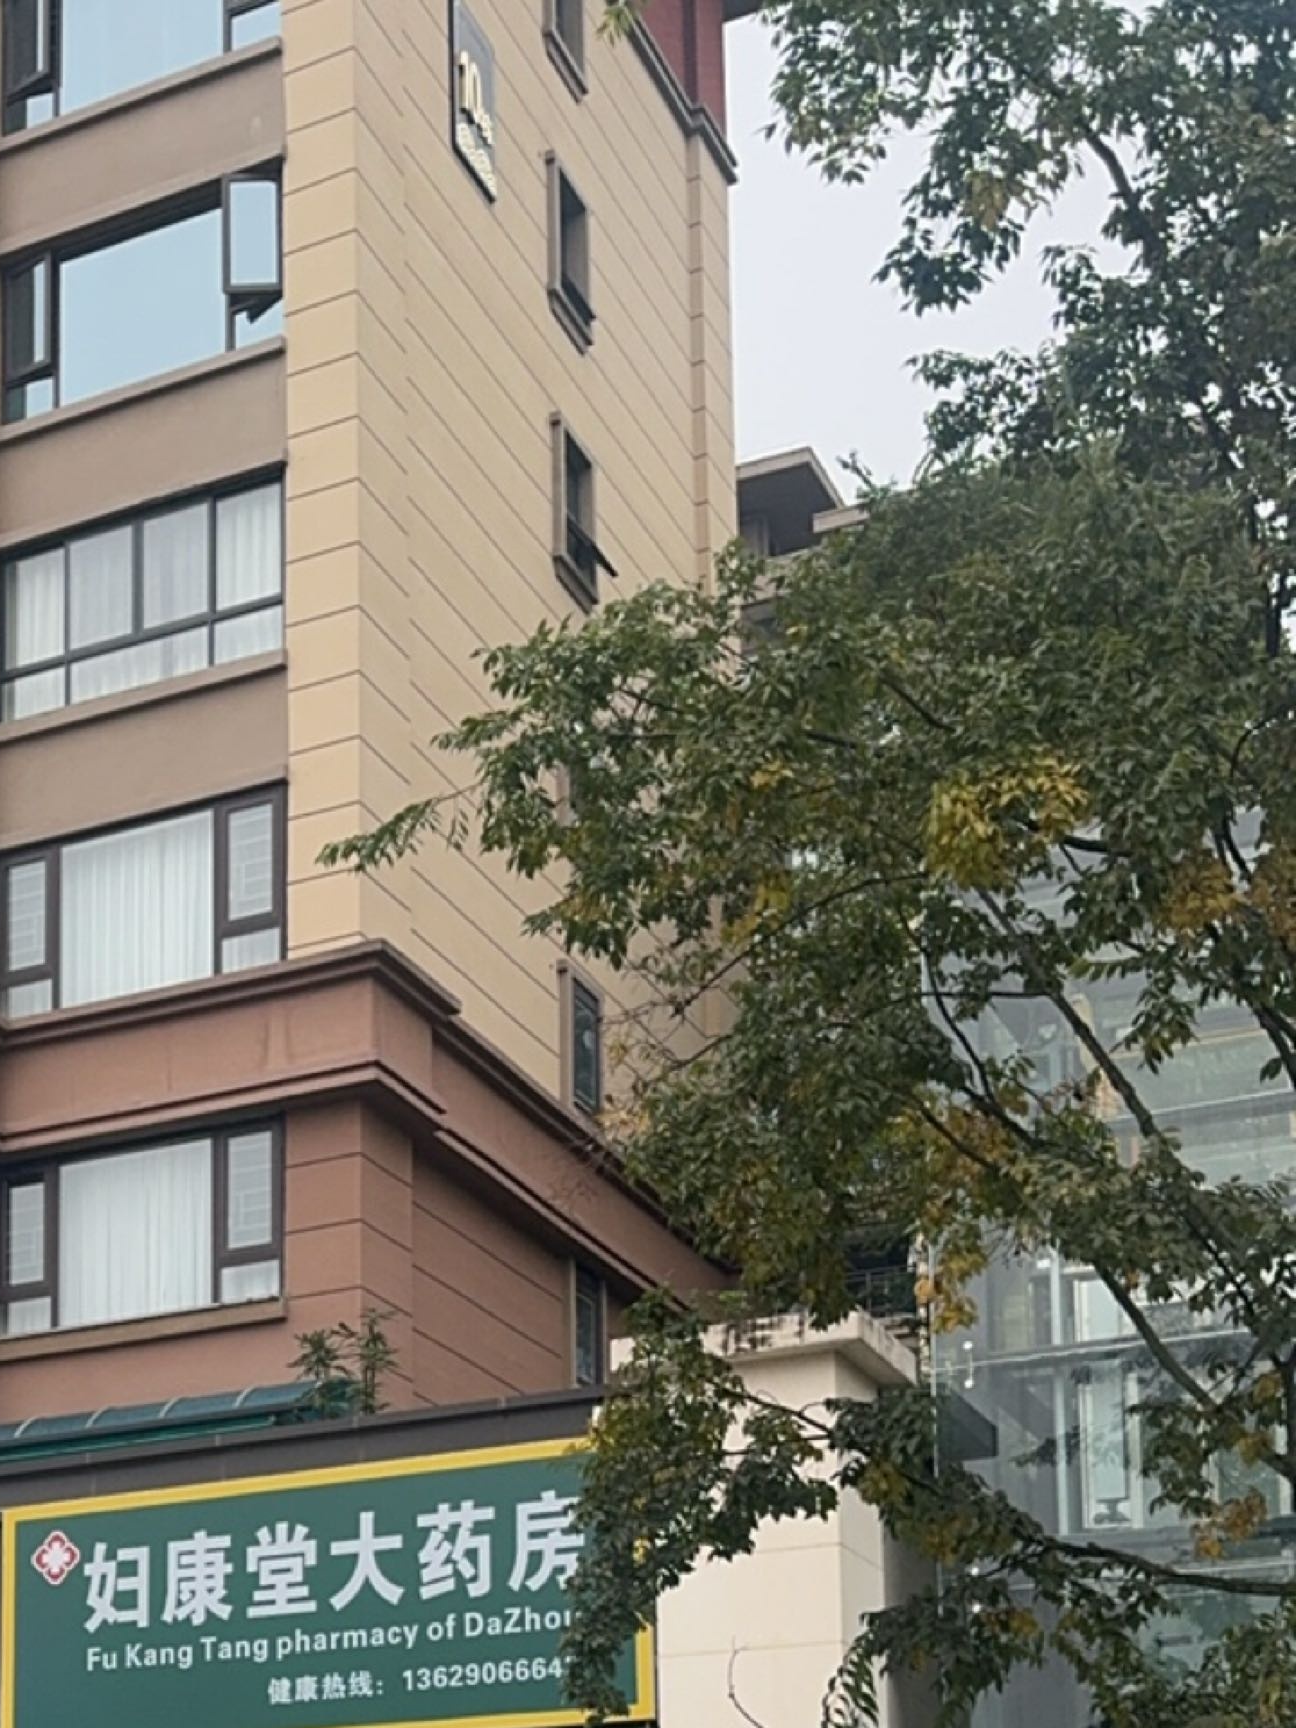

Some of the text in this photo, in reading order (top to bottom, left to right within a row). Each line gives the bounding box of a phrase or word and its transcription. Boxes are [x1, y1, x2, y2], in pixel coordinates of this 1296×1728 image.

[83, 1490, 585, 1634] 妇康堂大药房
[86, 1646, 118, 1672] Fu
[125, 1640, 194, 1671] Kang
[200, 1634, 269, 1664] Tang
[275, 1622, 418, 1661] pharmacy
[427, 1615, 457, 1641] of
